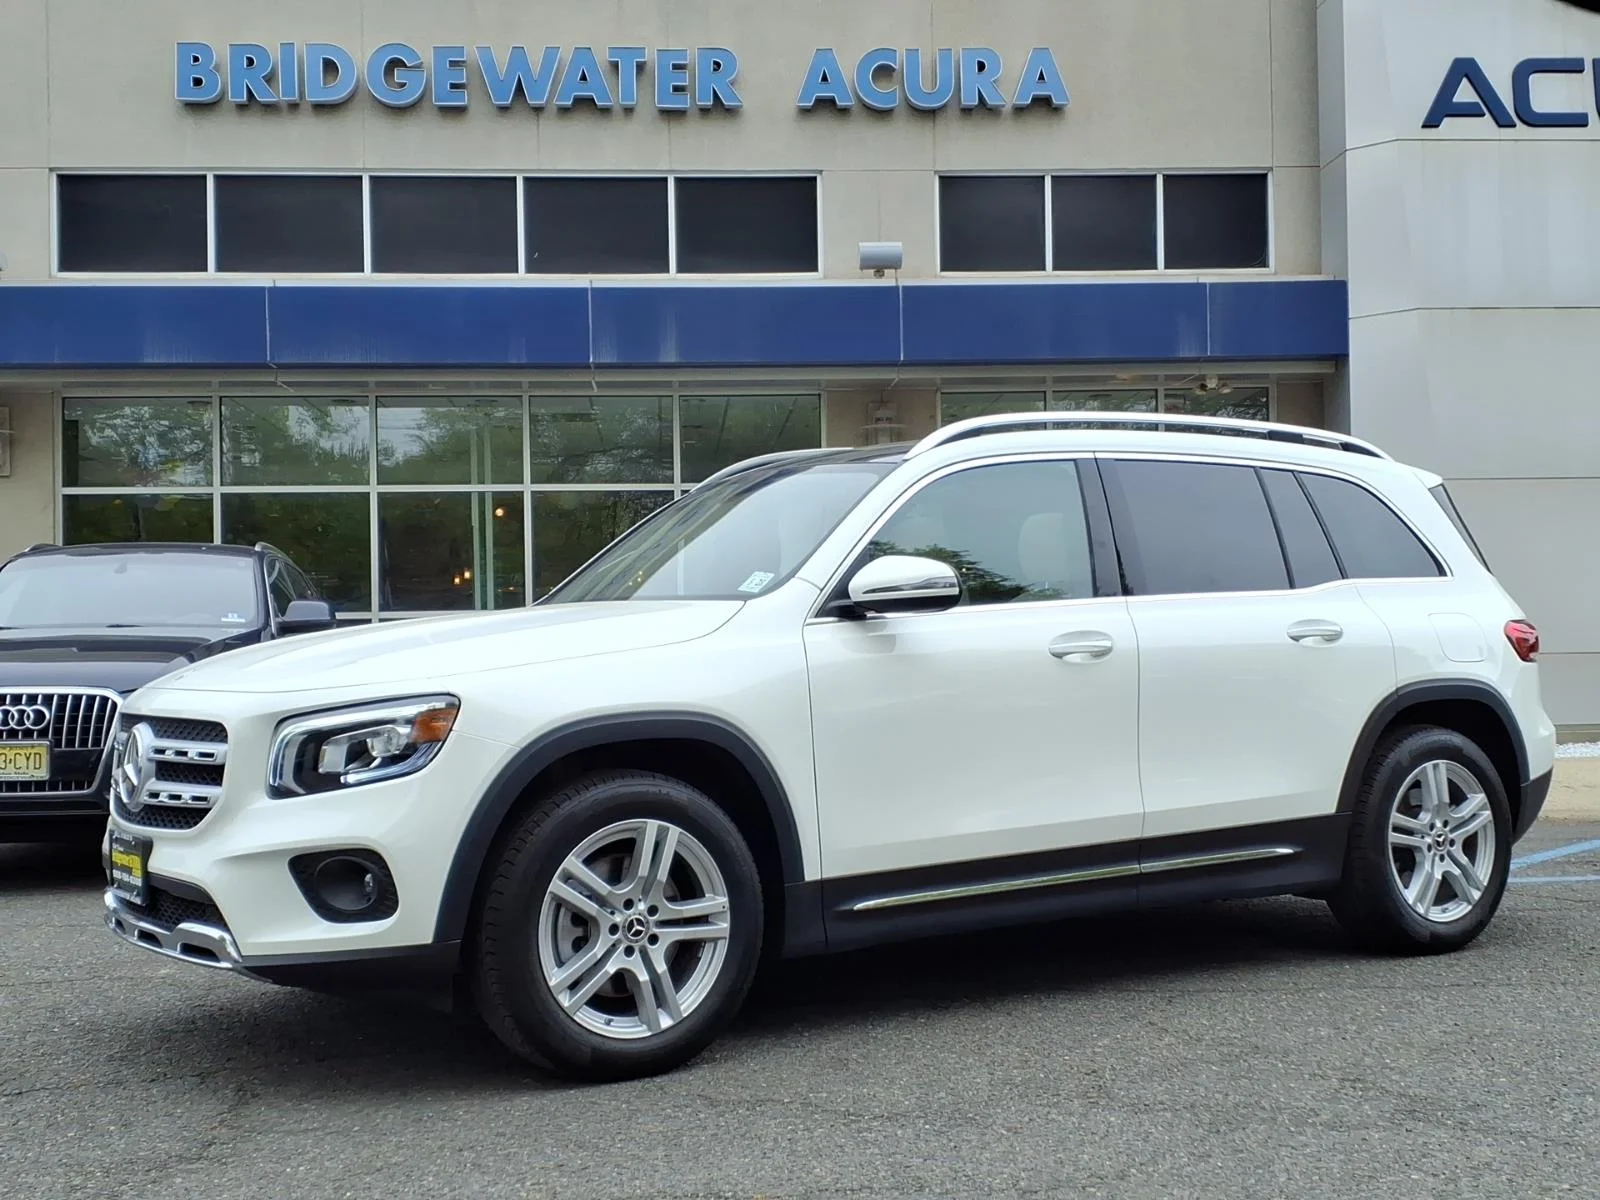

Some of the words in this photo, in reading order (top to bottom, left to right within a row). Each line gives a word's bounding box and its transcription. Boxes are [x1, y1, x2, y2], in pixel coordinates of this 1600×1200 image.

[175, 42, 743, 110] BRIDGEWATER
[796, 47, 1071, 110] ACURA
[1421, 57, 1600, 128] AC
